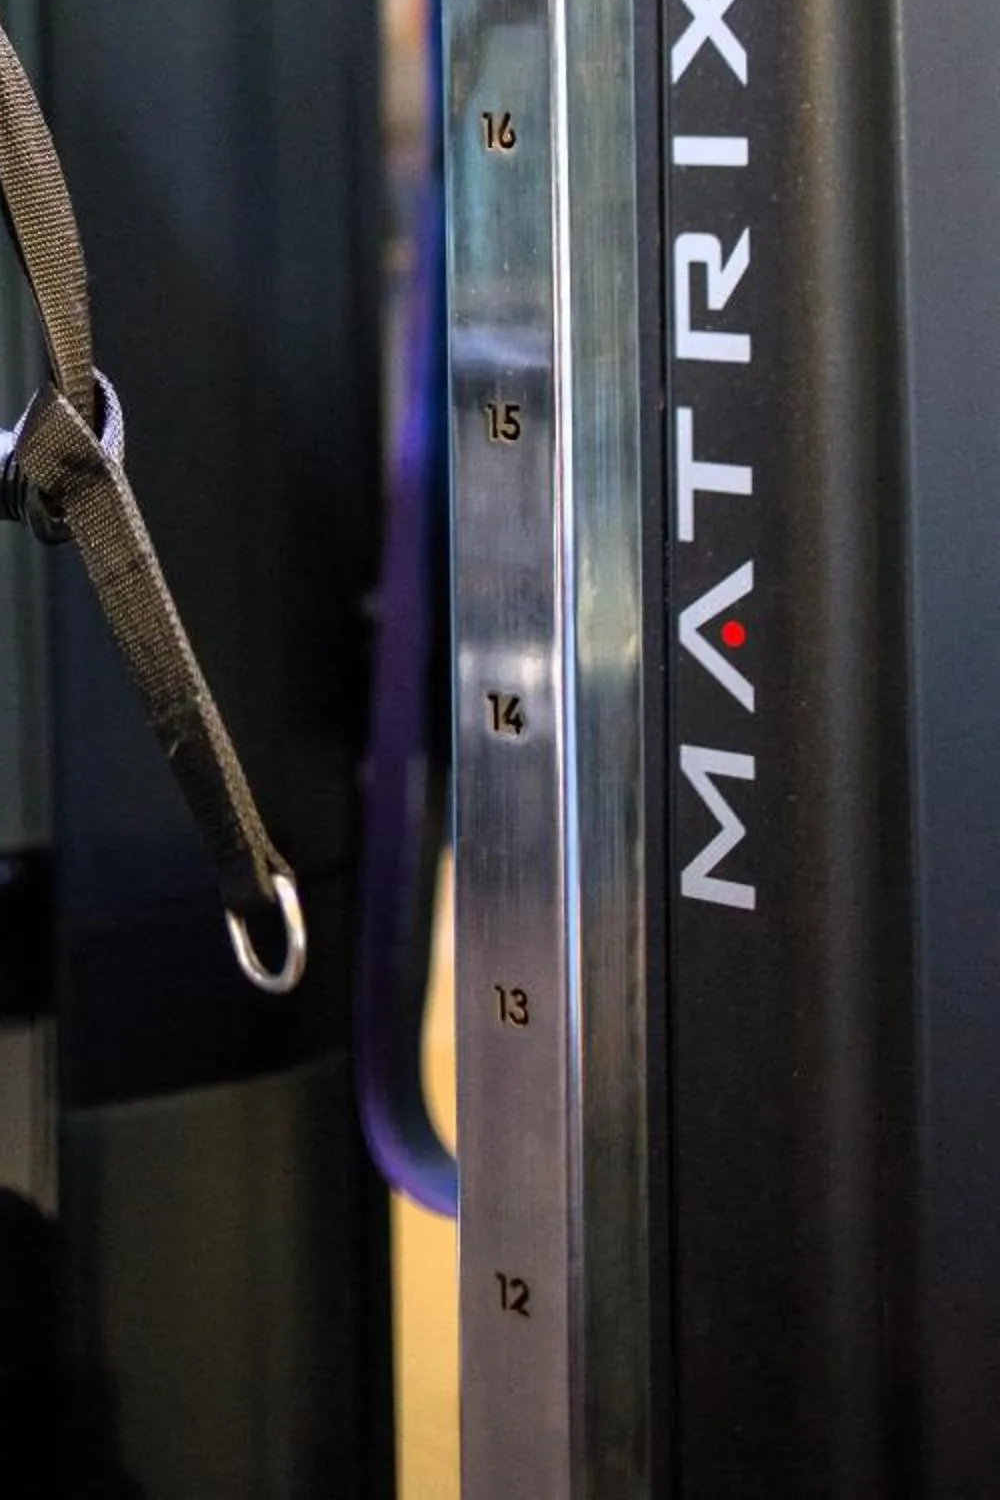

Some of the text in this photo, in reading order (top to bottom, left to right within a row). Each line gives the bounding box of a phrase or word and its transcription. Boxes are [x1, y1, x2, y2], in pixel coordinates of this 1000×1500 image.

[482, 112, 517, 149] 16
[486, 404, 521, 441] 15
[487, 694, 524, 735] 14
[495, 985, 529, 1025] 13
[496, 1273, 530, 1317] 12
